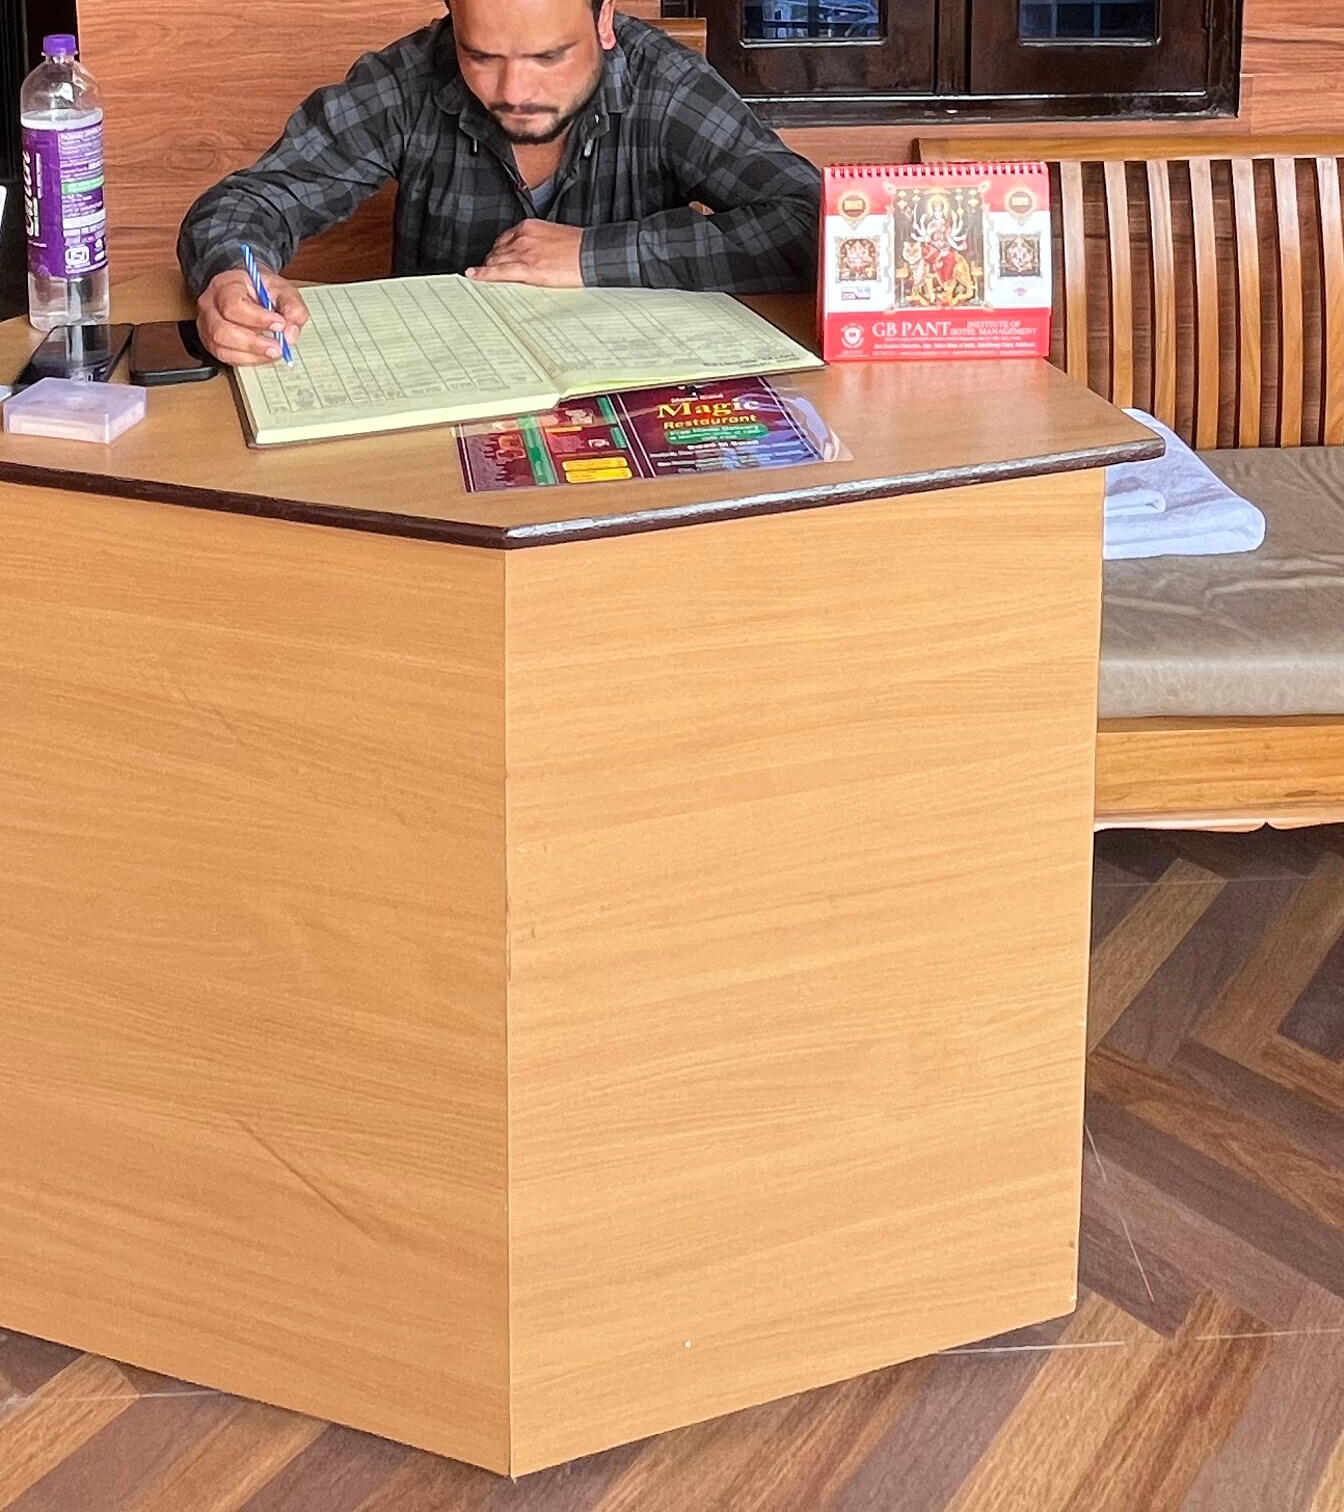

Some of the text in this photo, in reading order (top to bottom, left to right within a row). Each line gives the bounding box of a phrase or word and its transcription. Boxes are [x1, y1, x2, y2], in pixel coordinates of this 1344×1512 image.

[871, 321, 952, 337] GB PANT
[656, 396, 760, 419] Magic
[664, 414, 757, 430] Restaurant
